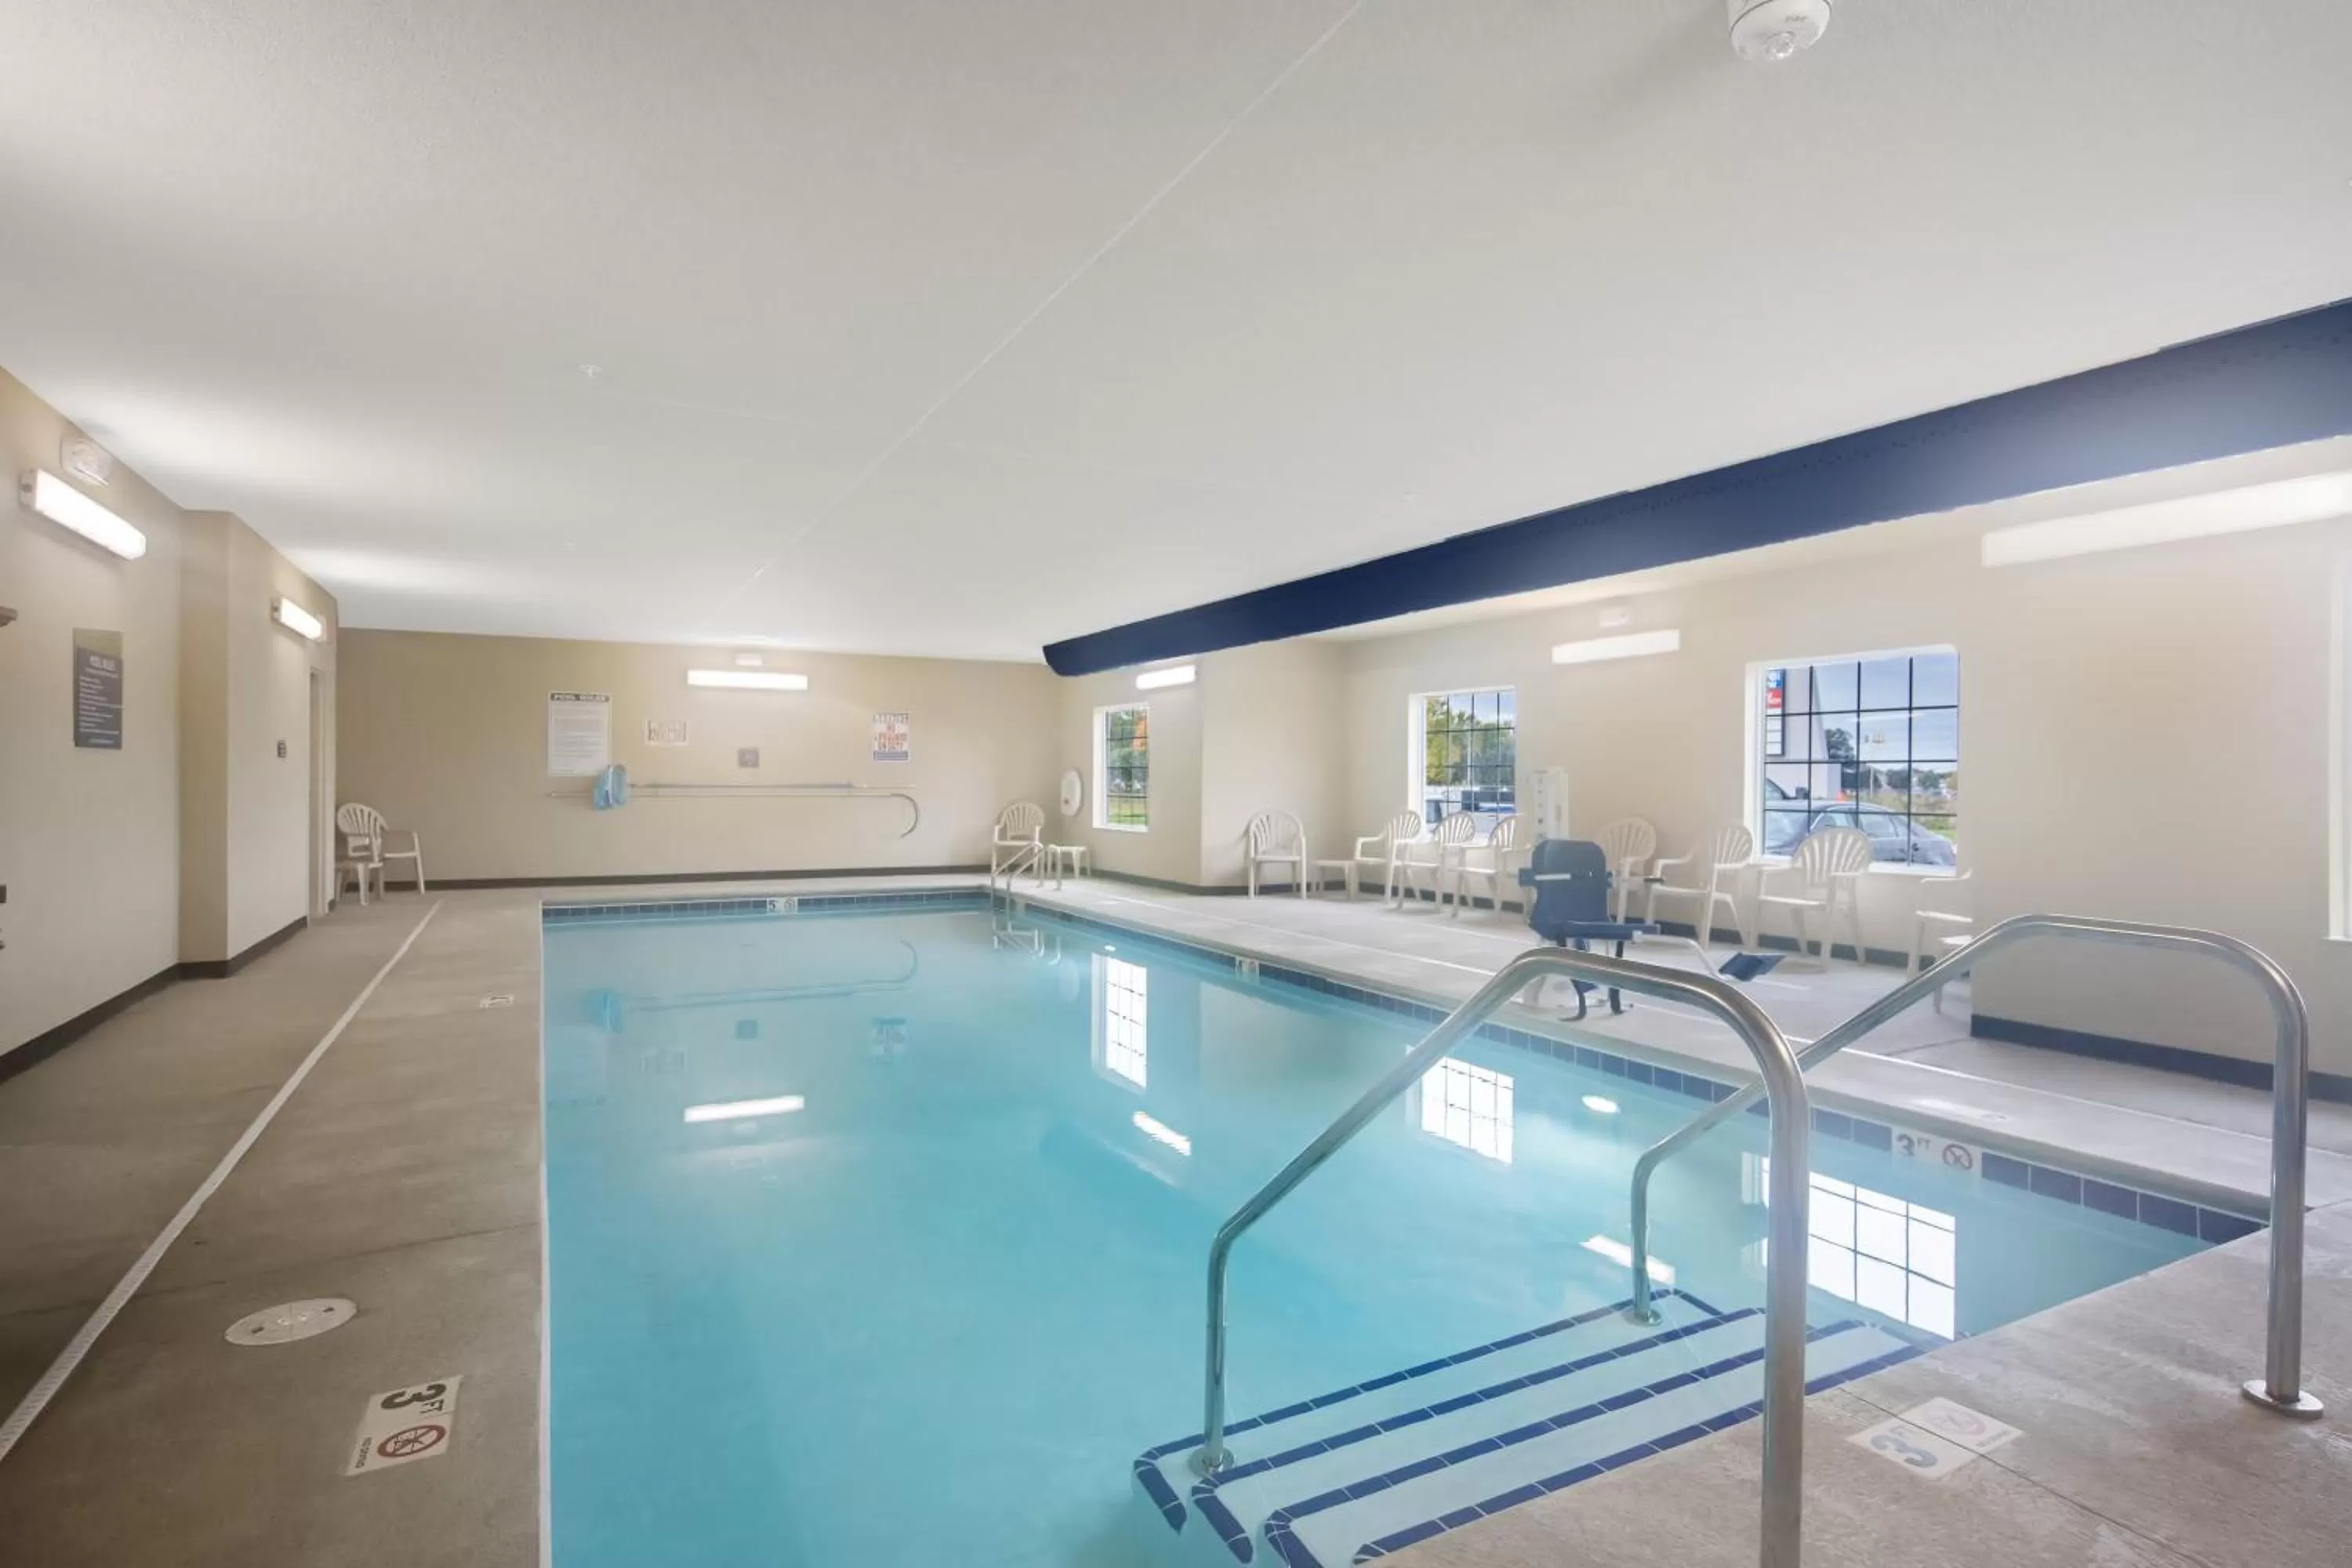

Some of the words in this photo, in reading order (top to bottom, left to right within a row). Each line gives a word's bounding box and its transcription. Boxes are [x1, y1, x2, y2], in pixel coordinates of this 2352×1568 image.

[381, 1384, 447, 1409] 3
[419, 1399, 444, 1413] FT
[1871, 1434, 1939, 1468] 3
